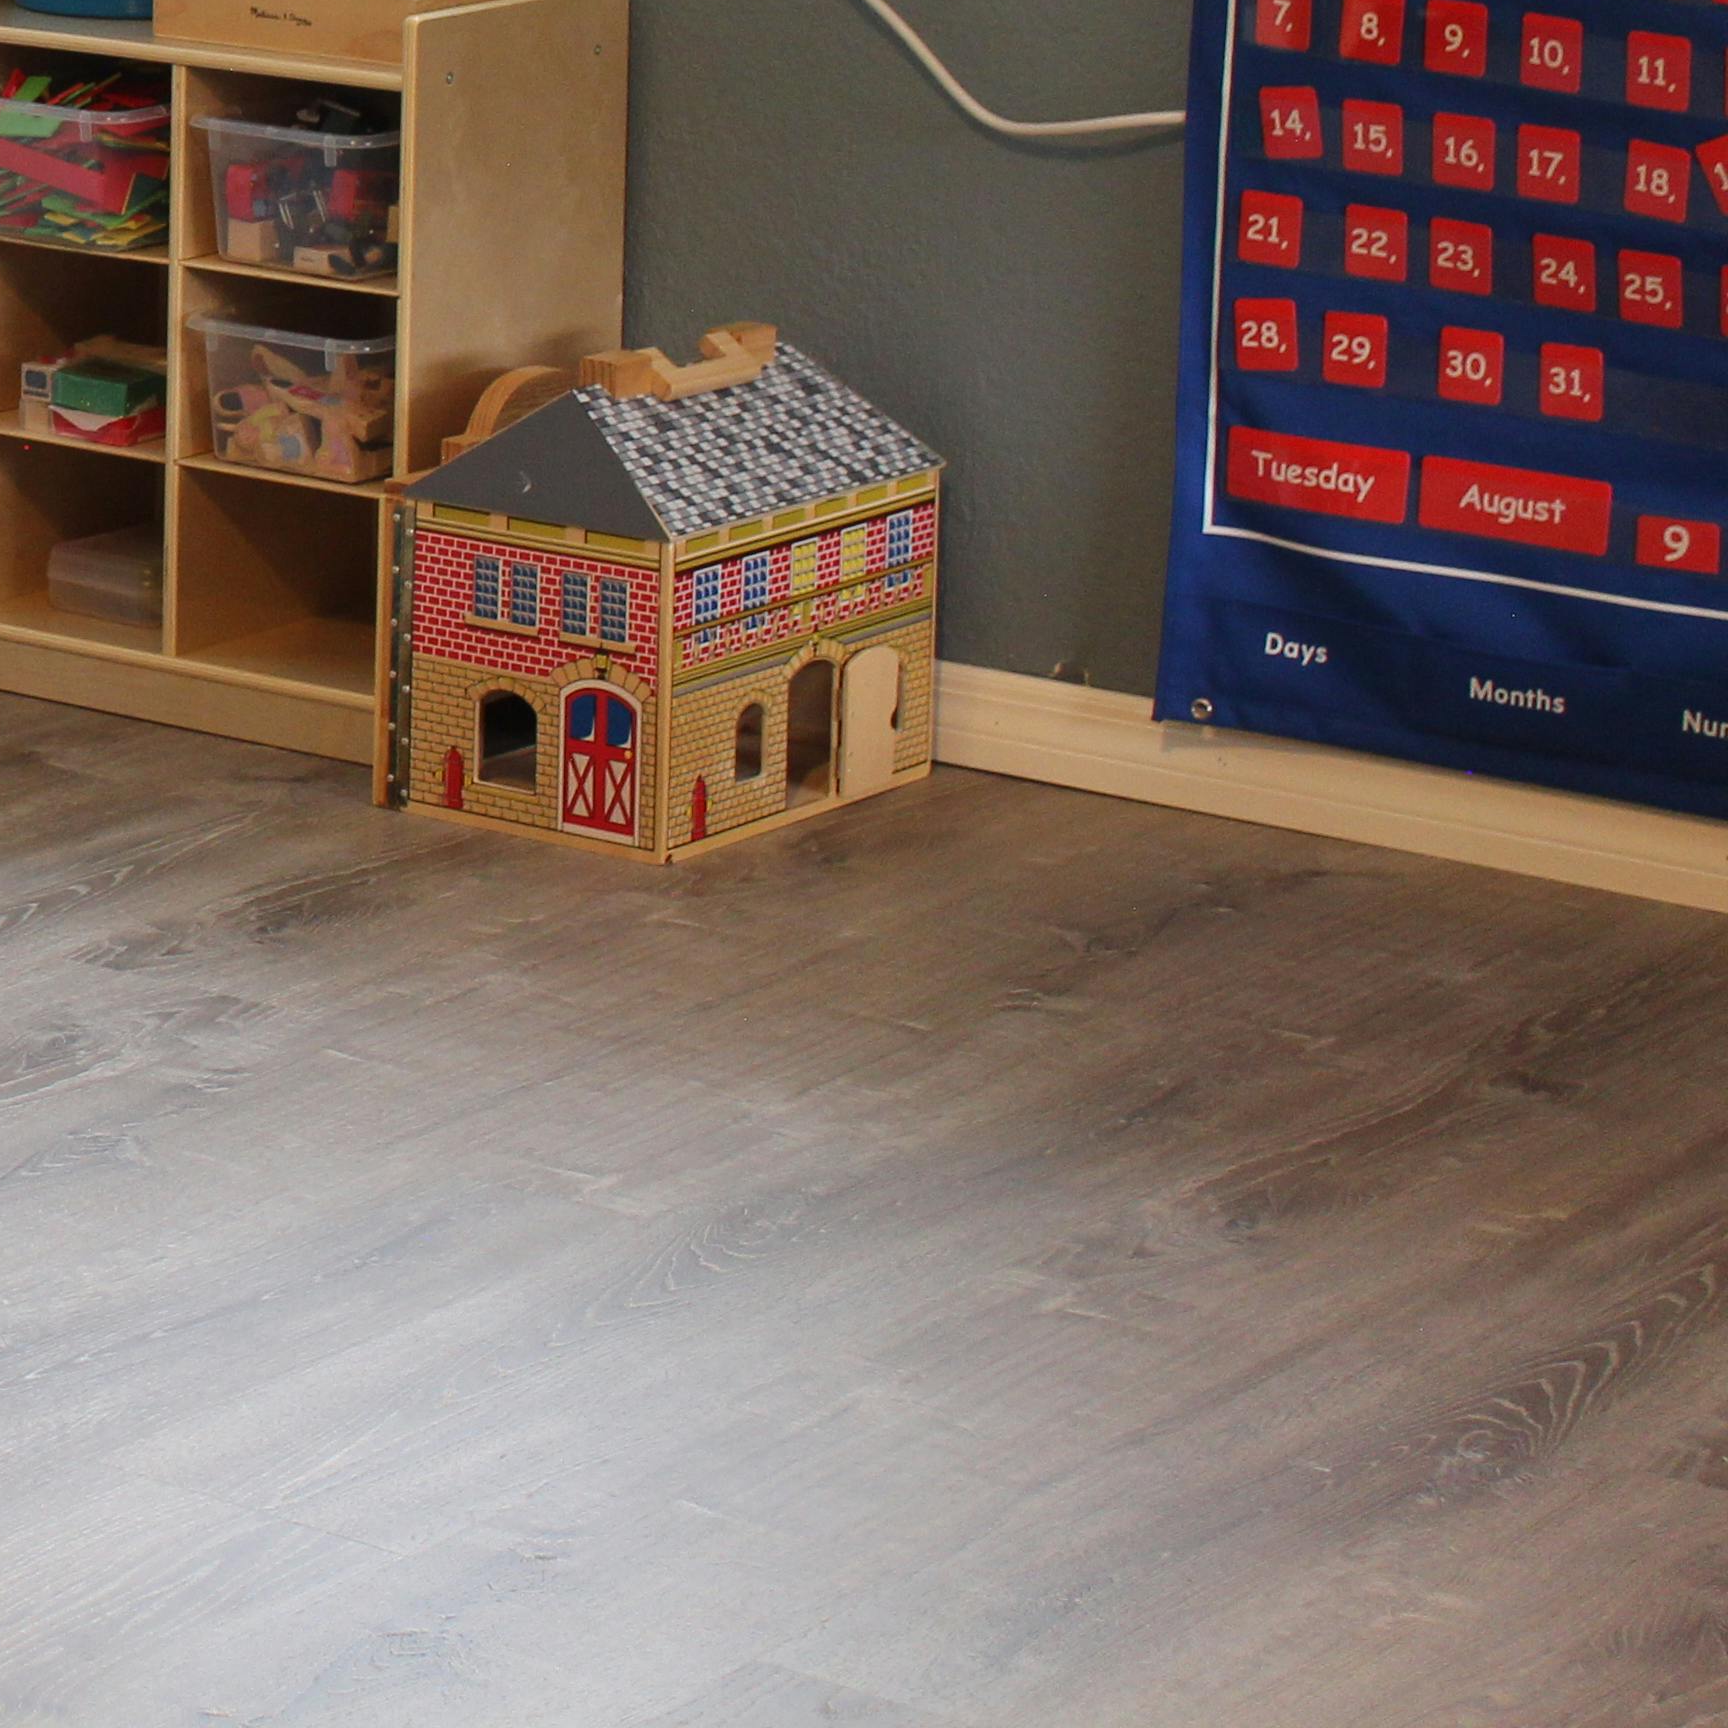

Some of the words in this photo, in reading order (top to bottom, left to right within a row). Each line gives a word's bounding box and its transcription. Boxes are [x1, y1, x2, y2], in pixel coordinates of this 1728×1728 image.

[1272, 0, 1292, 32] 7,
[1360, 12, 1385, 46] 8,
[1444, 24, 1470, 58] 9,
[1528, 37, 1570, 75] 10,
[1637, 56, 1677, 92] 11,
[1270, 109, 1311, 141] 14,
[1353, 123, 1393, 158] 15,
[1444, 136, 1485, 173] 16,
[1527, 149, 1566, 185] 17,
[1634, 163, 1676, 204] 18,
[1246, 214, 1288, 250] 21,
[1350, 228, 1396, 264] 22,
[1436, 241, 1480, 278] 23,
[1540, 257, 1585, 294] 24,
[1624, 273, 1672, 310] 25,
[1241, 320, 1287, 354] 28,
[1330, 334, 1376, 370] 29,
[1445, 350, 1493, 387] 30,
[1548, 367, 1591, 404] 31,
[1251, 449, 1375, 503] Tuesday
[1459, 483, 1566, 524] August
[1662, 525, 1690, 562] 9
[1264, 632, 1328, 666] Days
[1469, 676, 1565, 714] Months
